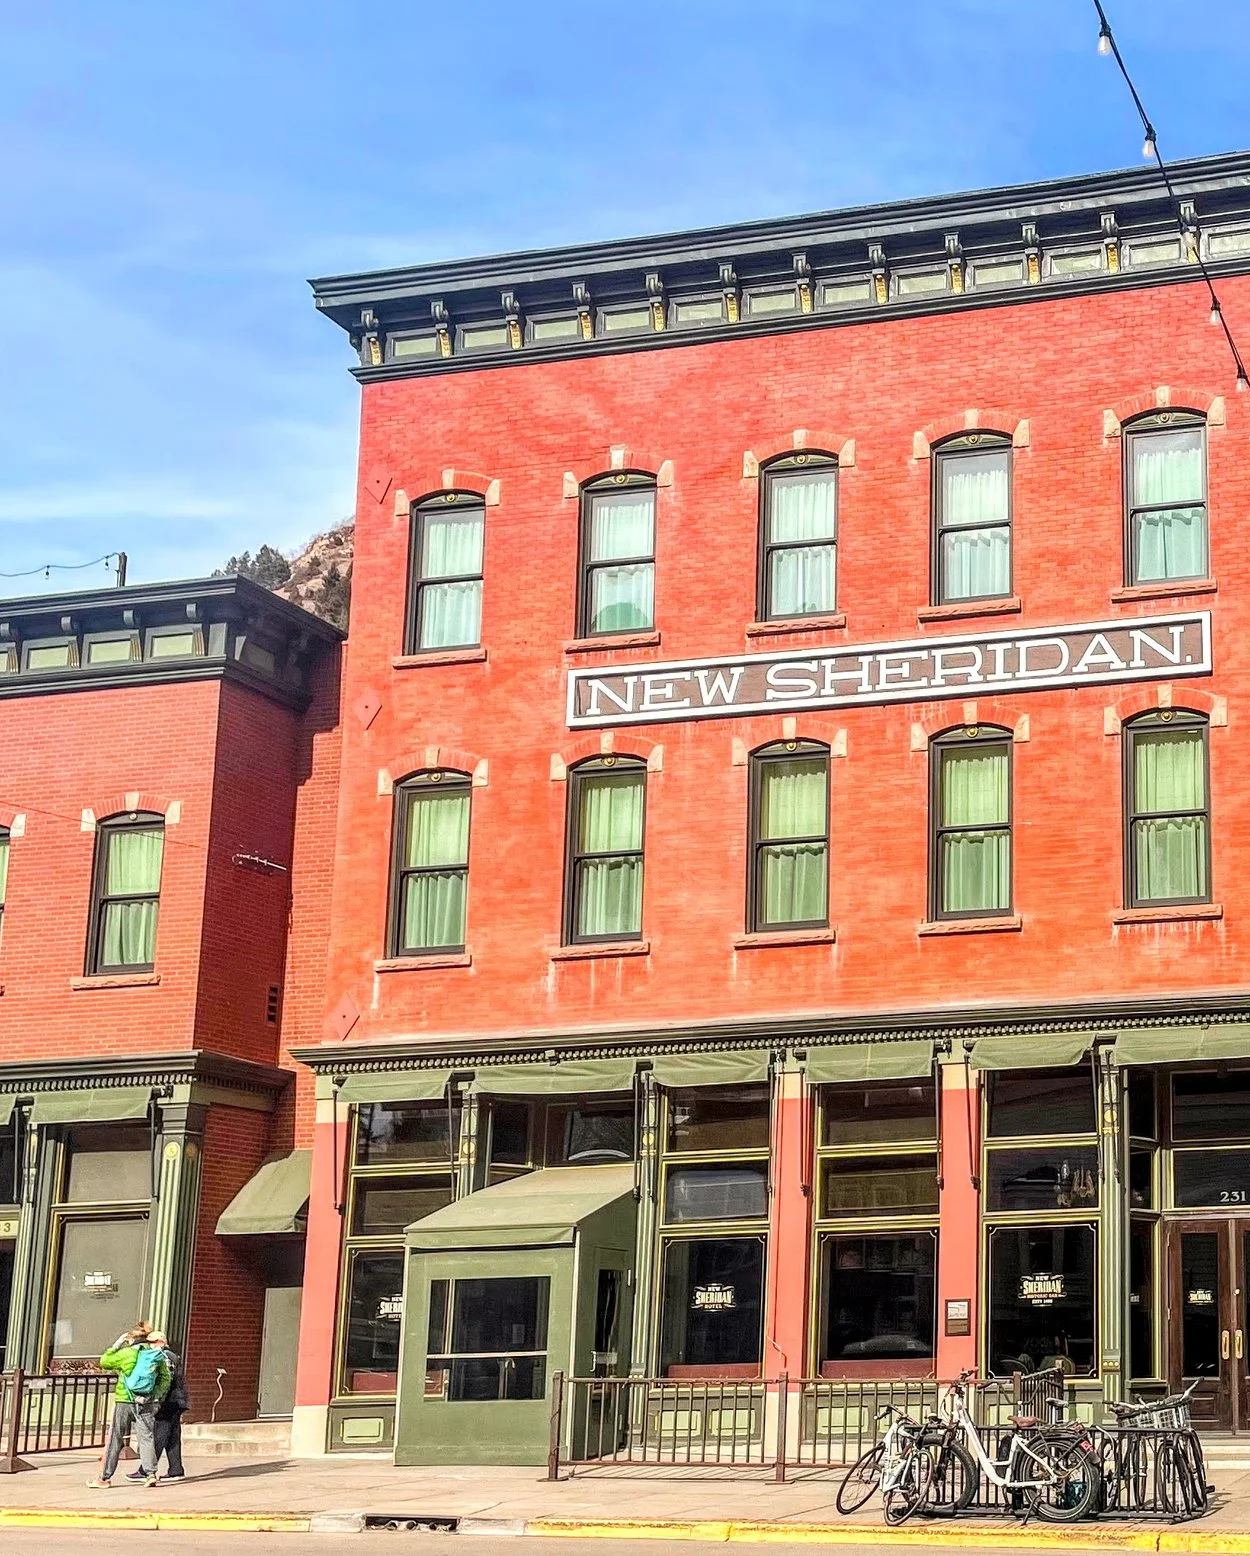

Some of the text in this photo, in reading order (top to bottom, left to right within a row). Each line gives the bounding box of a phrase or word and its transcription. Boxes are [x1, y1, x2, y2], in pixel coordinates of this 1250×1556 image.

[586, 666, 745, 716] NEW
[1220, 1190, 1247, 1203] 231
[1023, 1280, 1061, 1295] SHERIDAN
[695, 1290, 732, 1305] SHERIDAN
